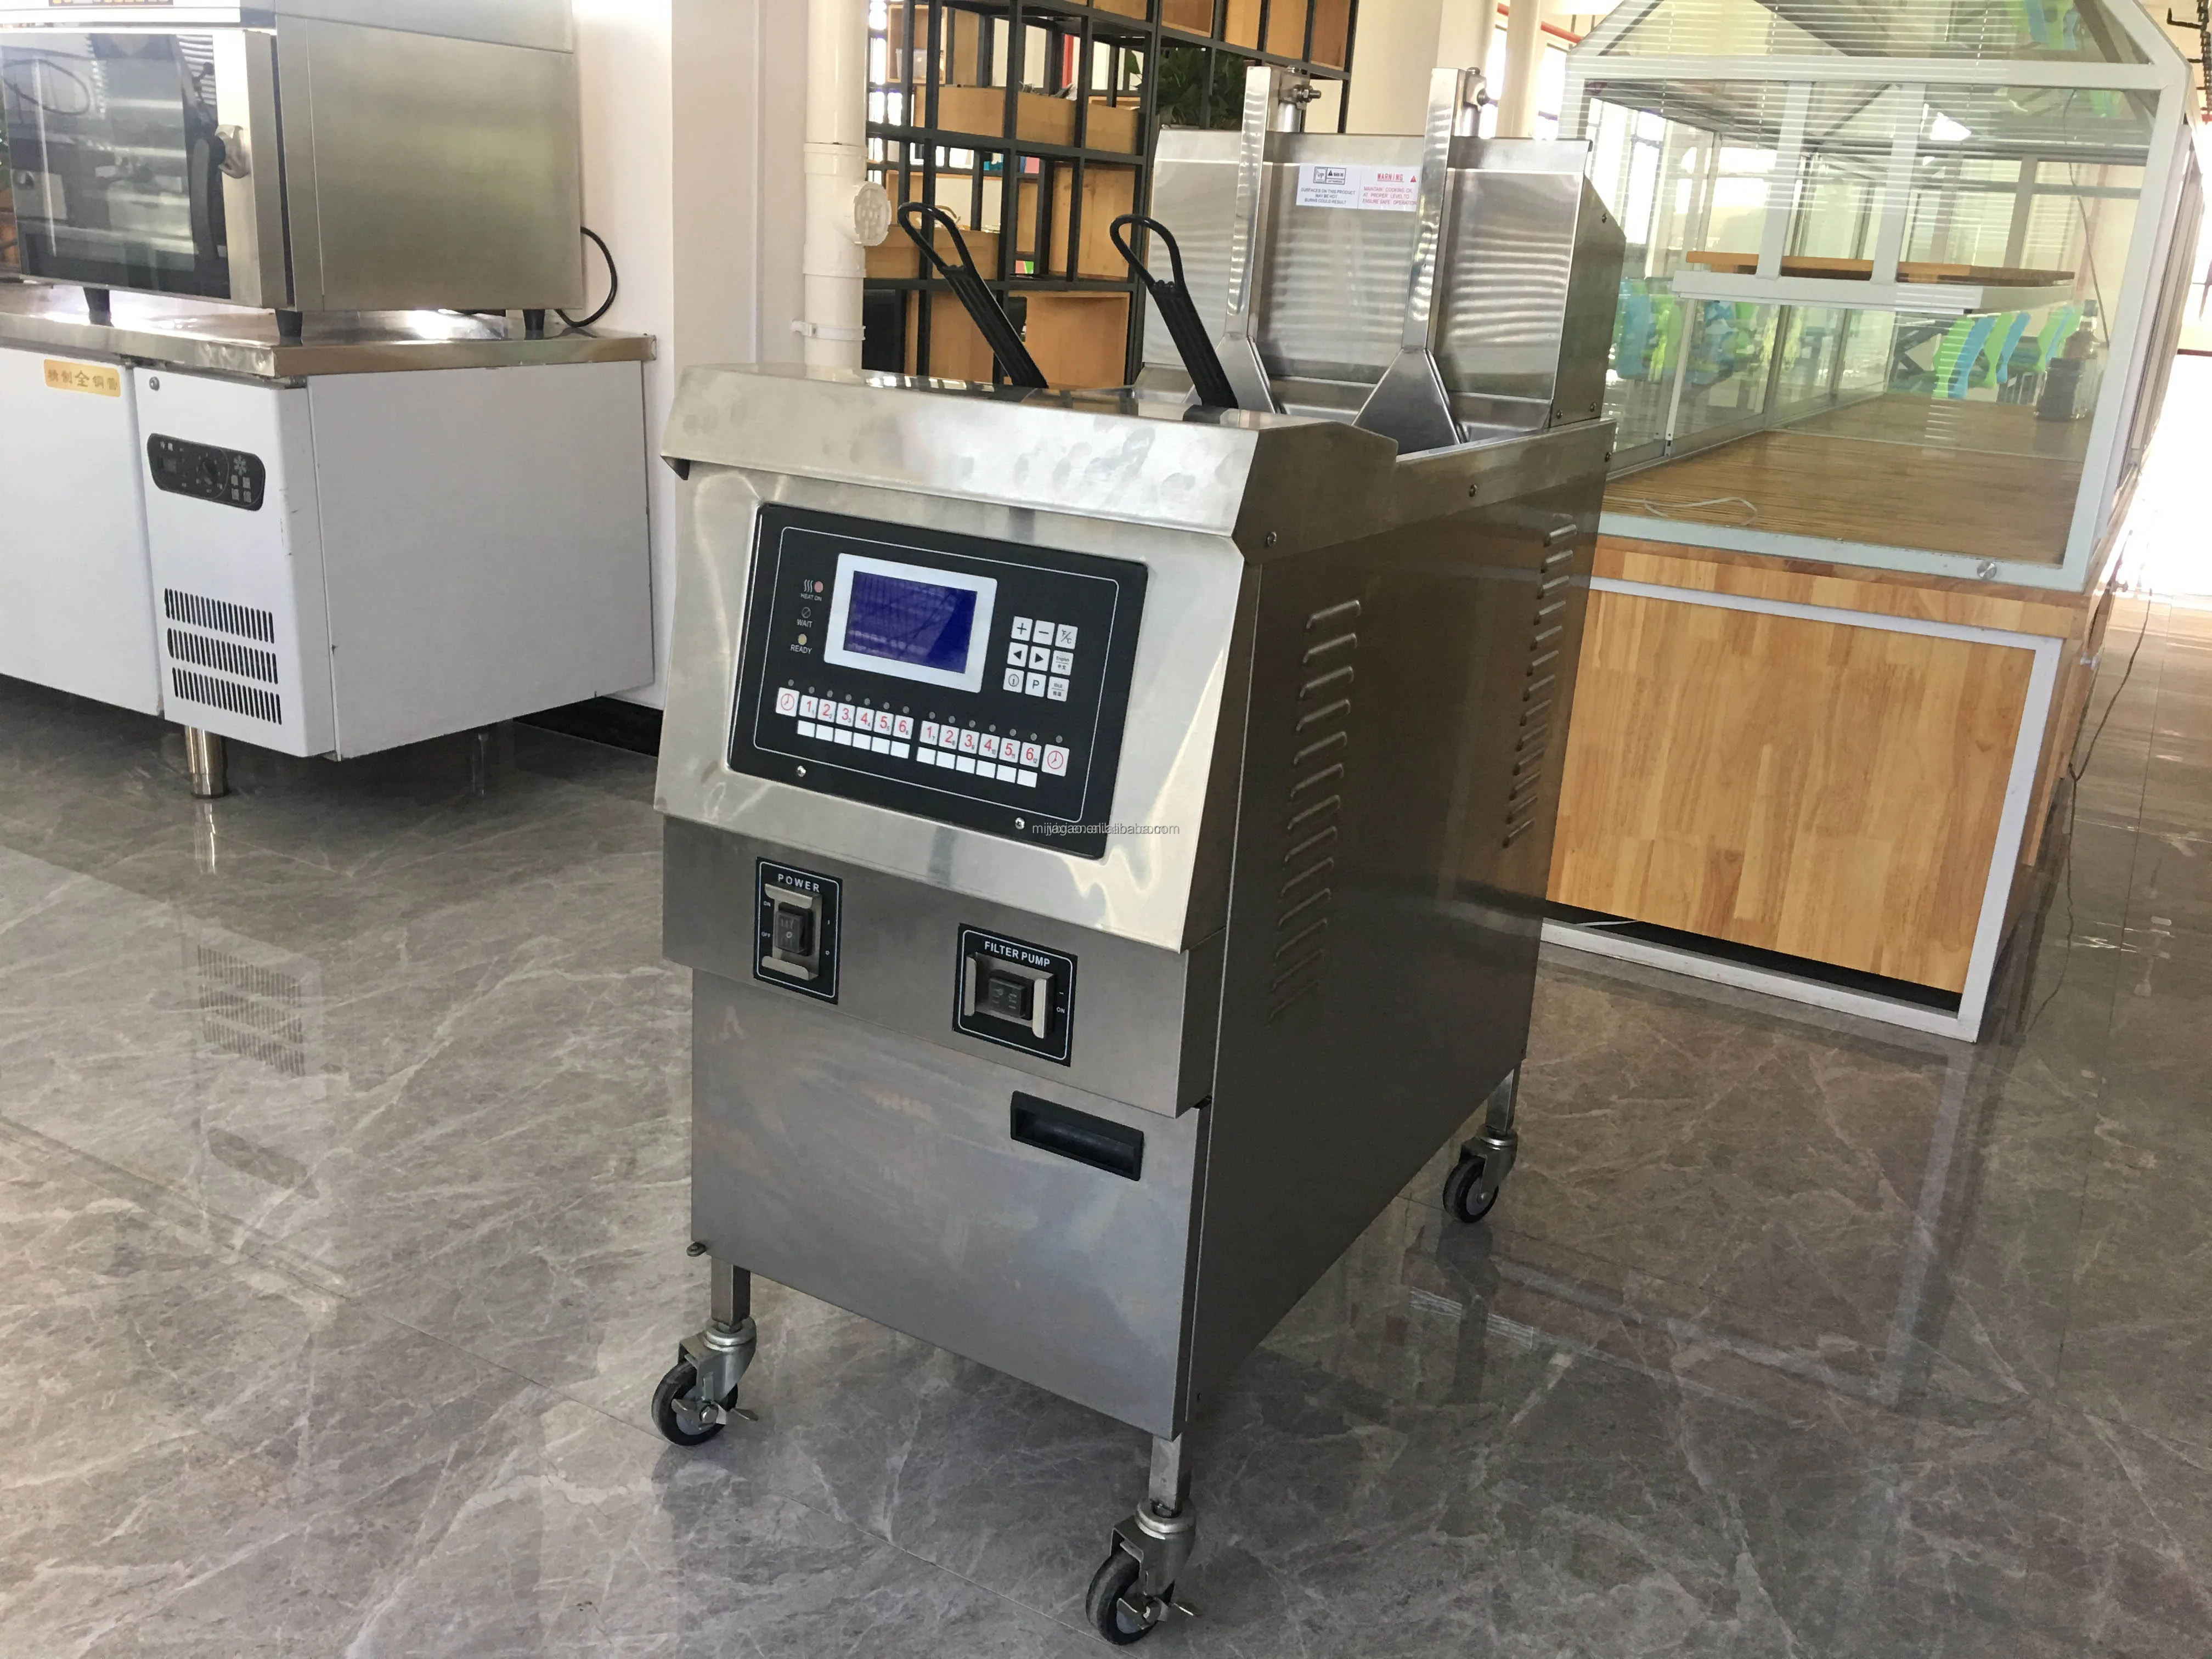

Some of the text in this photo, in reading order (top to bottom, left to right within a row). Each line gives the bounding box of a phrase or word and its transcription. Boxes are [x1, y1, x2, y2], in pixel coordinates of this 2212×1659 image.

[797, 619, 812, 628] WAIT
[790, 644, 812, 654] READY
[1032, 680, 1040, 689] P
[806, 700, 811, 713] 1
[822, 704, 831, 716] 2
[842, 708, 849, 720] 3
[860, 712, 868, 725] 4
[880, 715, 887, 729] 5
[899, 720, 906, 732] 6
[927, 726, 932, 738] 1
[945, 730, 953, 743] 2
[964, 734, 972, 747] 3
[984, 739, 992, 752] 4
[1005, 743, 1013, 756] 5
[1026, 747, 1034, 761] 6
[778, 873, 820, 893] POWER
[985, 941, 1050, 967] FILTER PUMP
